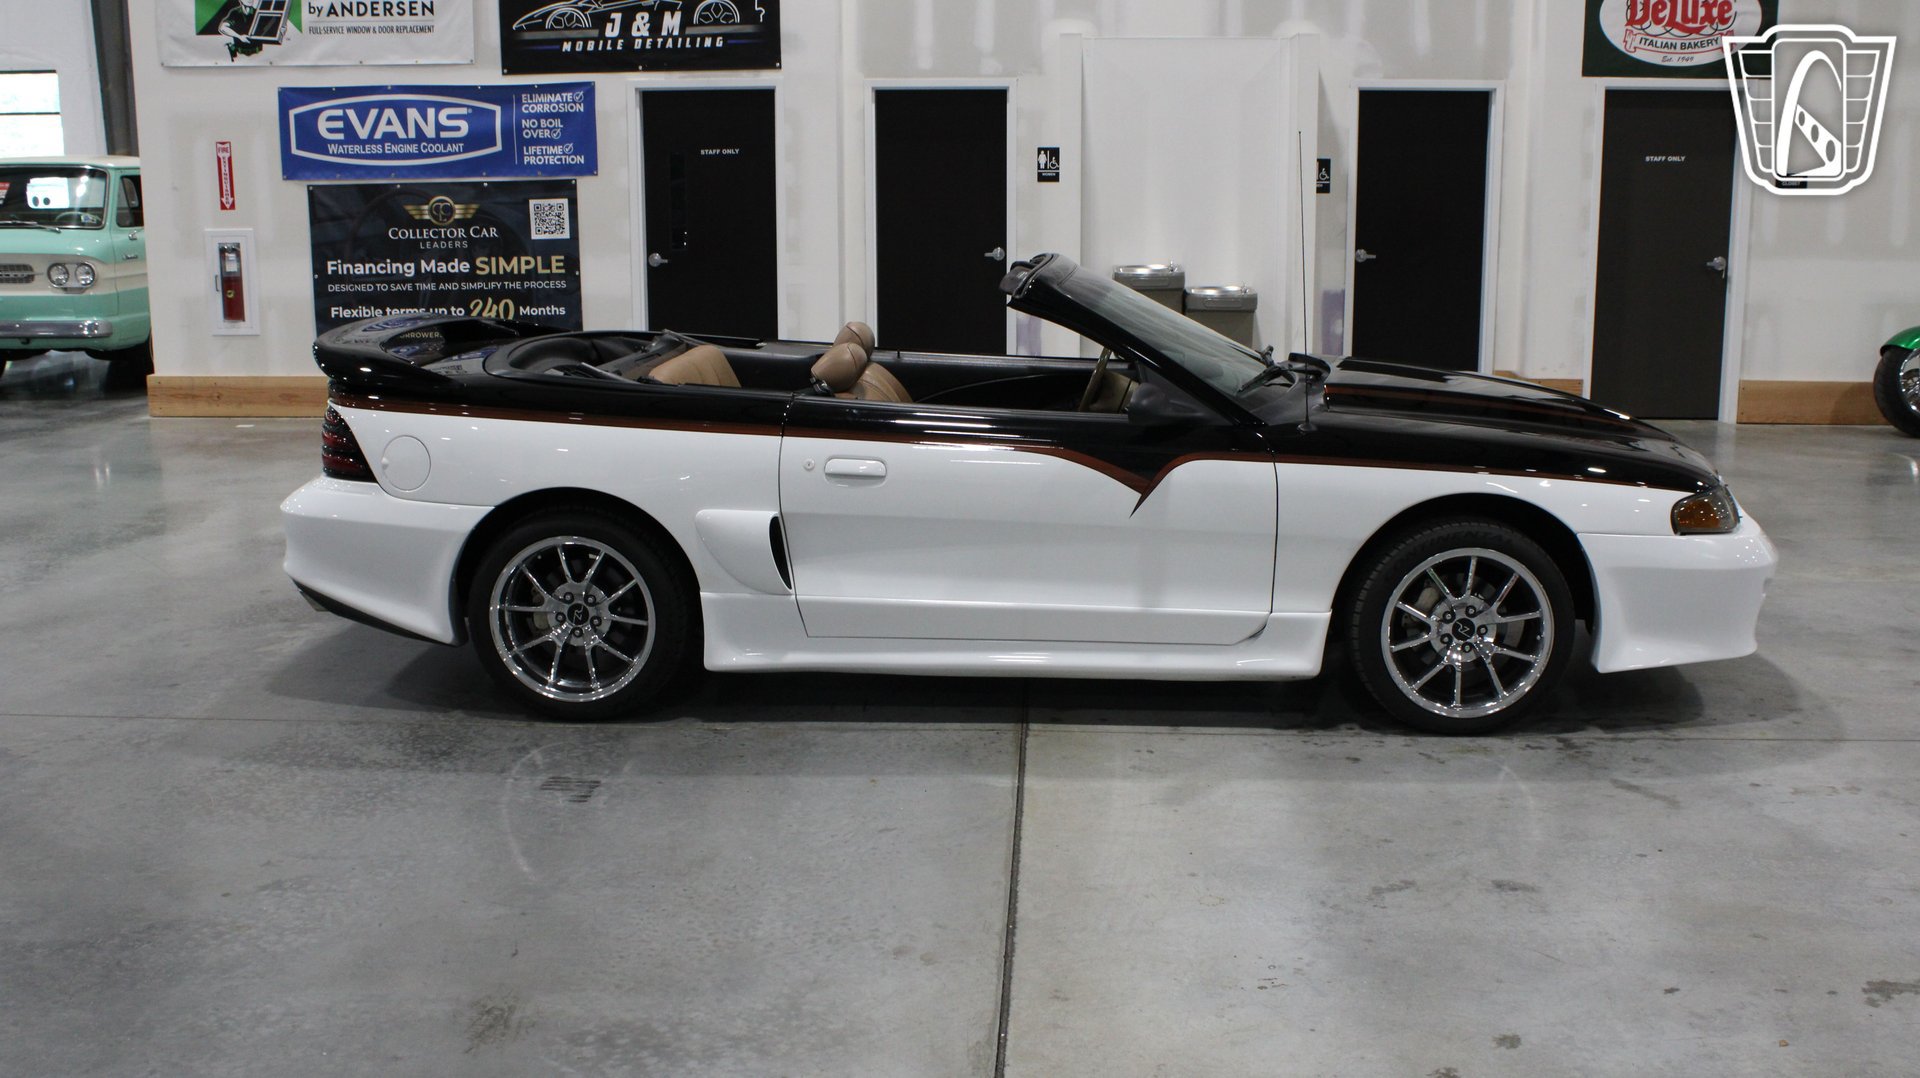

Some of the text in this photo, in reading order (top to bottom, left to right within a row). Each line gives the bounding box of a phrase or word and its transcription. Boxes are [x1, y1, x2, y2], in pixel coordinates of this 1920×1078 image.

[309, 1, 434, 17] by ANDERSEN
[346, 26, 371, 34] WINDOW
[378, 25, 394, 34] DOOR
[395, 25, 434, 34] REPLACEMENT
[604, 11, 682, 38] J & M
[562, 36, 724, 53] MOBILE DETAILING
[1639, 37, 1720, 51] ITALIAN BAKERY
[522, 93, 573, 104] ELIMINATE
[522, 103, 584, 113] CORROSION
[317, 107, 468, 140] EVANS
[522, 118, 563, 129] NO BOIL
[523, 129, 551, 139] OVER
[217, 146, 229, 154] FIRE
[328, 141, 464, 155] WATERLESS ENGINE COOLANT
[523, 146, 563, 156] LIFETIME
[523, 155, 585, 165] PROTECTION
[388, 226, 499, 240] COLLECTOR CAR
[420, 241, 468, 249] LEADERS
[327, 255, 566, 277] Financing Made SIMPLE
[327, 280, 567, 292] DESIGNED TO SAVE TIME AND SIMPLIFY THE PROCESS
[331, 305, 383, 318] Flexible
[450, 305, 465, 316] to
[469, 296, 515, 320] 240
[519, 305, 566, 316] Months
